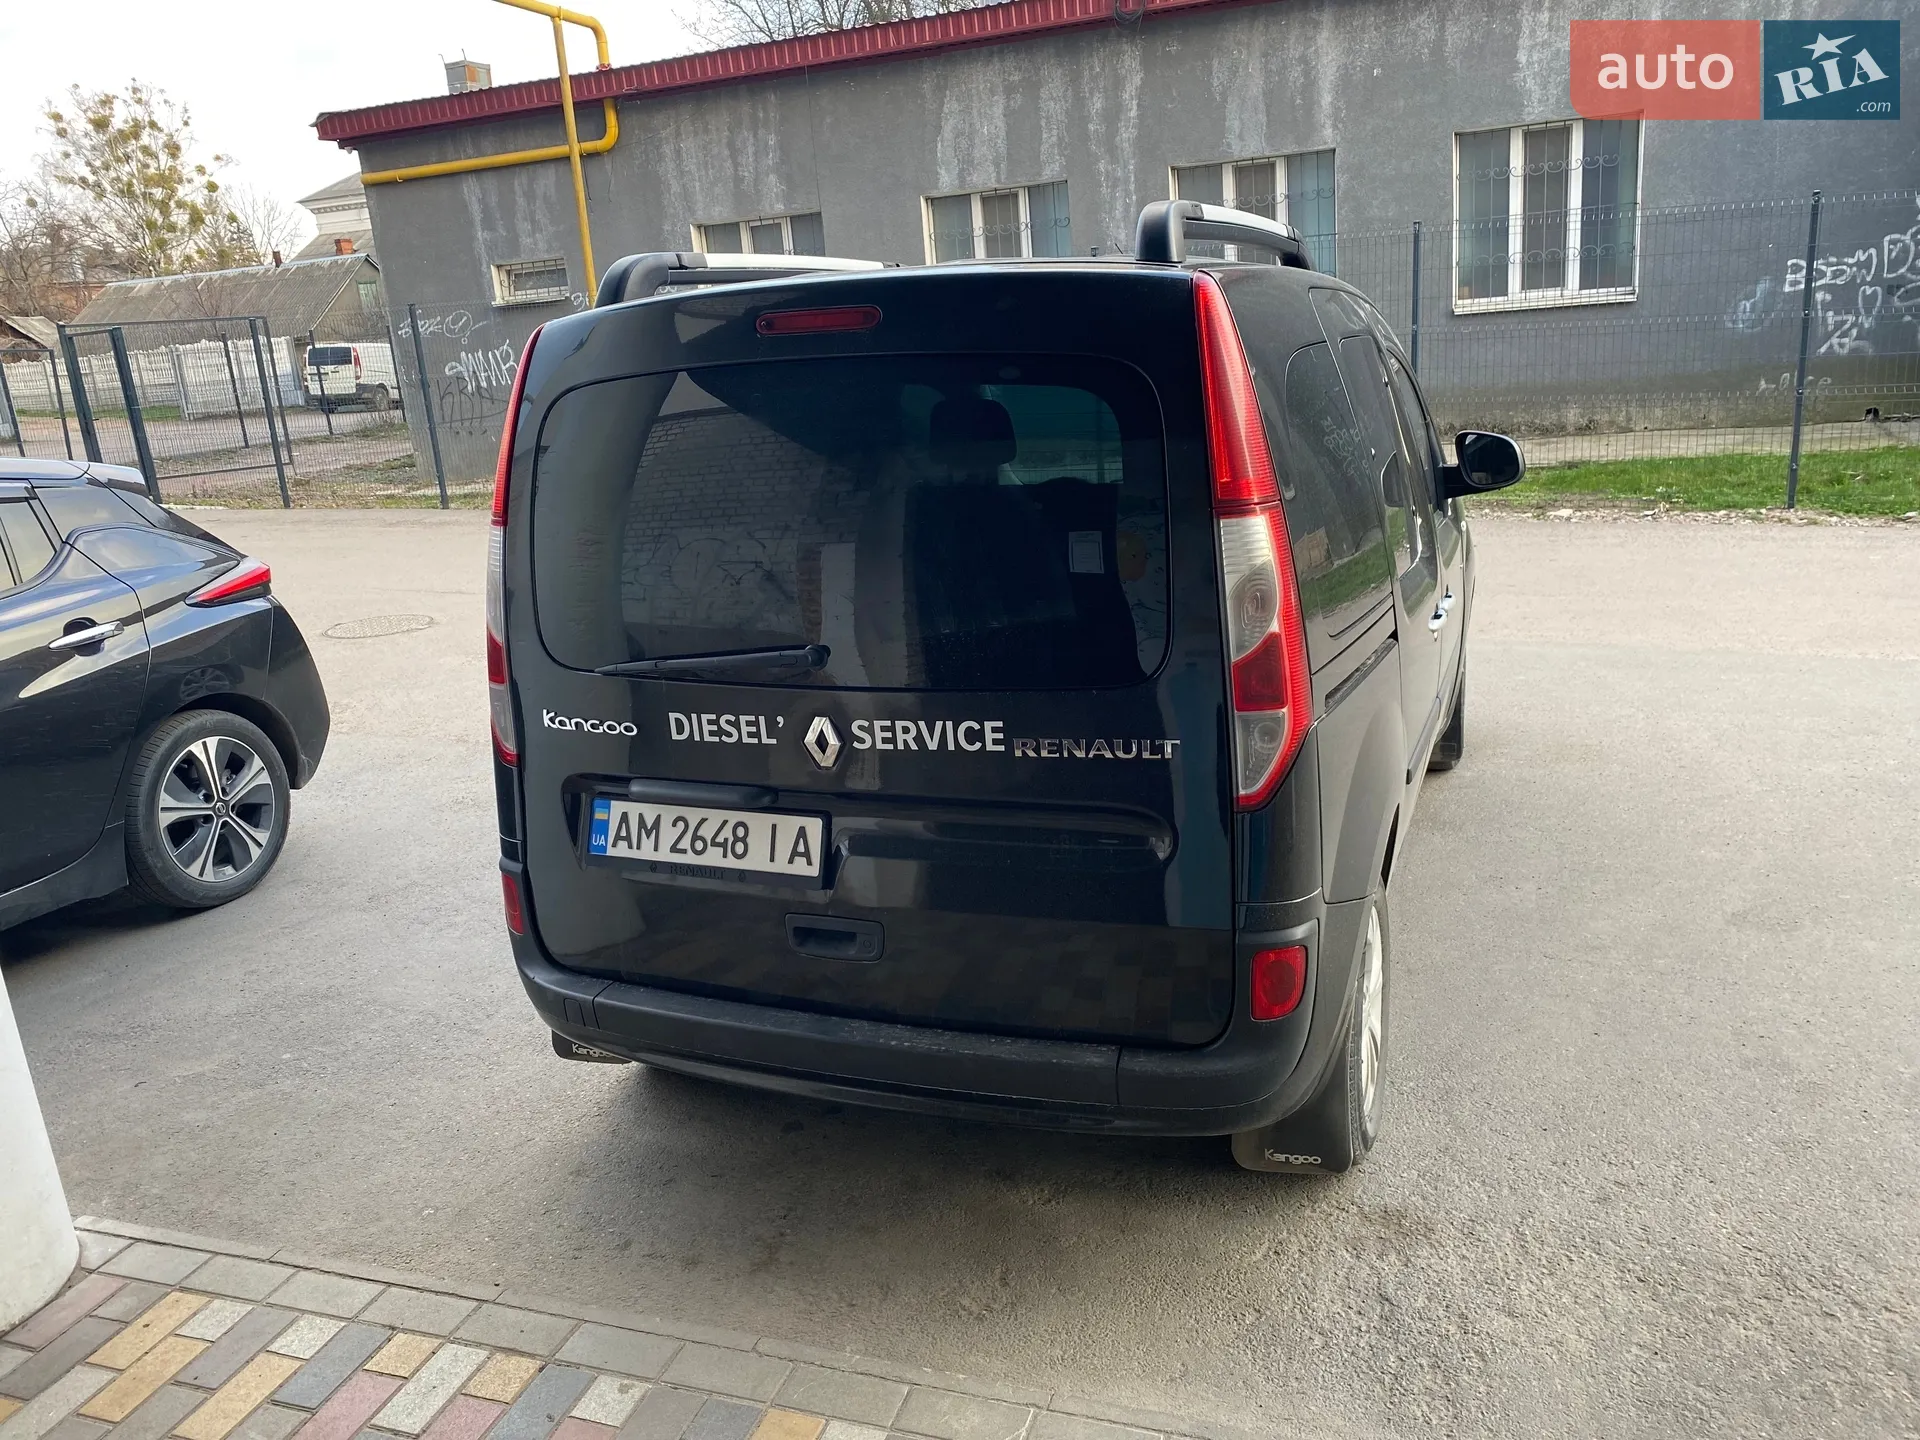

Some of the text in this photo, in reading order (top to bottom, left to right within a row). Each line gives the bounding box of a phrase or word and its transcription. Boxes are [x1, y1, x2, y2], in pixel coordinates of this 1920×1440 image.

[851, 719, 1005, 752] SERVICE
[1013, 737, 1181, 760] RENAULT
[592, 834, 606, 847] UA
[611, 811, 813, 867] AM 2648 IA
[670, 864, 726, 880] RENAULT
[1264, 1148, 1322, 1165] Kangoo
